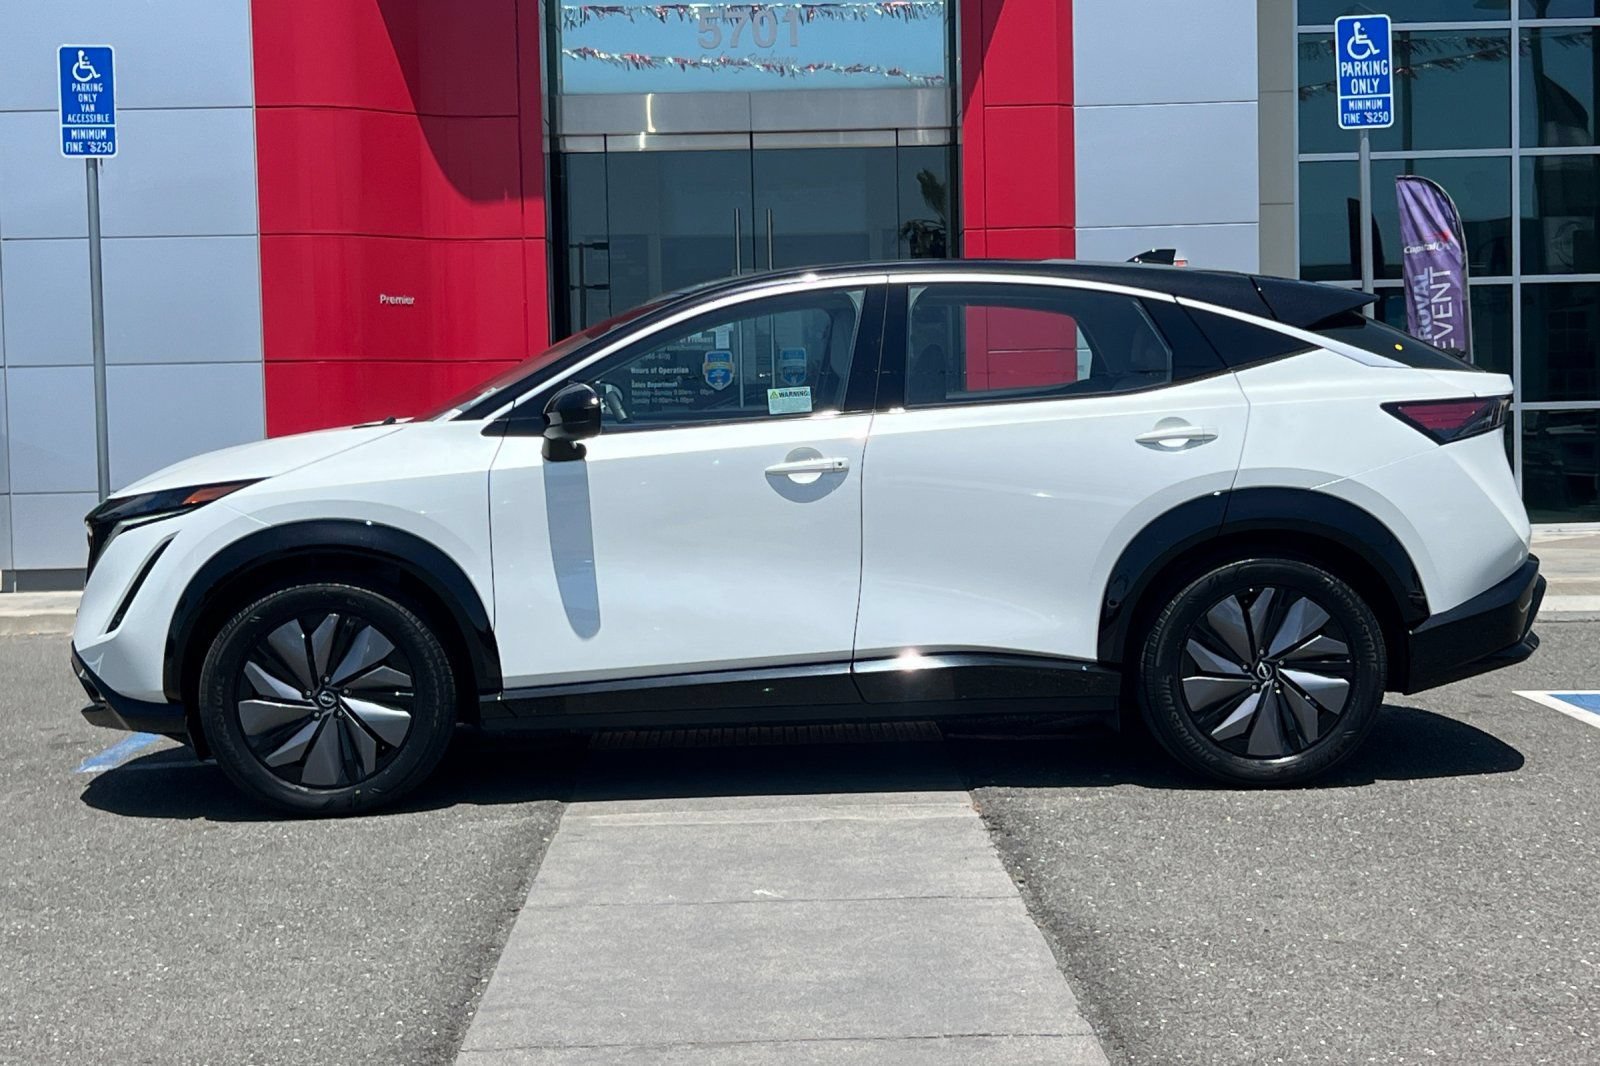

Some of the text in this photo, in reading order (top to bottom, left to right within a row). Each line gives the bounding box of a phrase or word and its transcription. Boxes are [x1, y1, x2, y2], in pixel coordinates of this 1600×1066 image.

[698, 6, 799, 49] 5701
[1341, 60, 1389, 77] PARKING
[71, 82, 103, 92] PARKING
[1351, 78, 1380, 95] ONLY
[78, 93, 97, 103] ONLY
[80, 103, 95, 113] VAN
[1348, 99, 1383, 111] MINIMUM
[67, 113, 110, 123] ACCESSIBLE
[1343, 112, 1361, 124] FINE
[71, 129, 107, 140] MINIMUM
[65, 142, 83, 153] FINE
[379, 293, 415, 305] Premier
[658, 367, 690, 375] Operation
